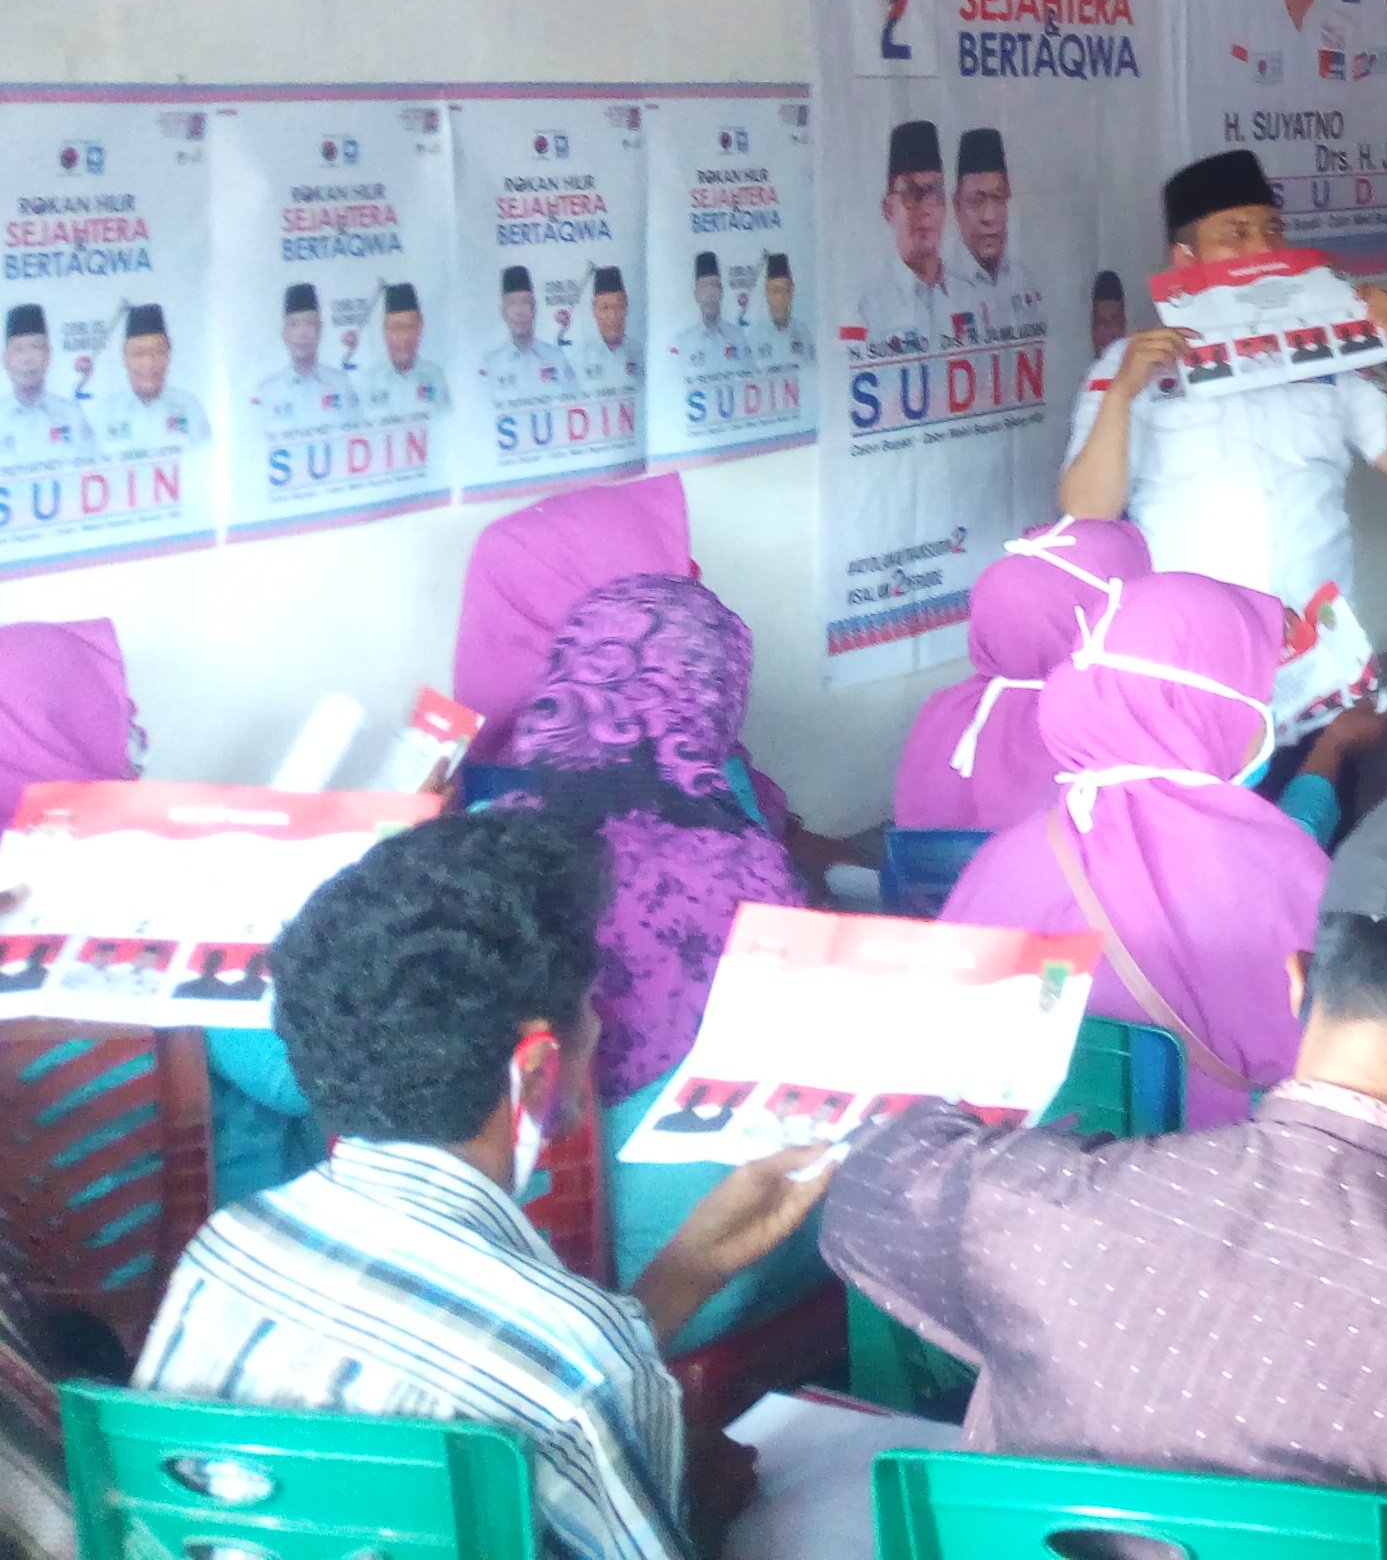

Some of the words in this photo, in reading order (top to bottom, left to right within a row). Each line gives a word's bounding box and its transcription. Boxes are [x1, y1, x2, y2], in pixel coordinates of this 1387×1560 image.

[958, 30, 1141, 80] BERTAQWA
[1223, 111, 1246, 142] H.
[1252, 109, 1345, 141] SUYATNO
[1315, 142, 1352, 173] Drs.
[496, 193, 608, 220] SEJAHTERA
[6, 216, 150, 247] SEJAHTERA
[496, 219, 612, 245] BERTAQWA
[3, 246, 154, 279] BERTAQWA
[686, 377, 800, 423] SUDIN
[850, 348, 1044, 429] SUDIN
[496, 400, 635, 451] SUDIN
[268, 426, 428, 487] SUDIN
